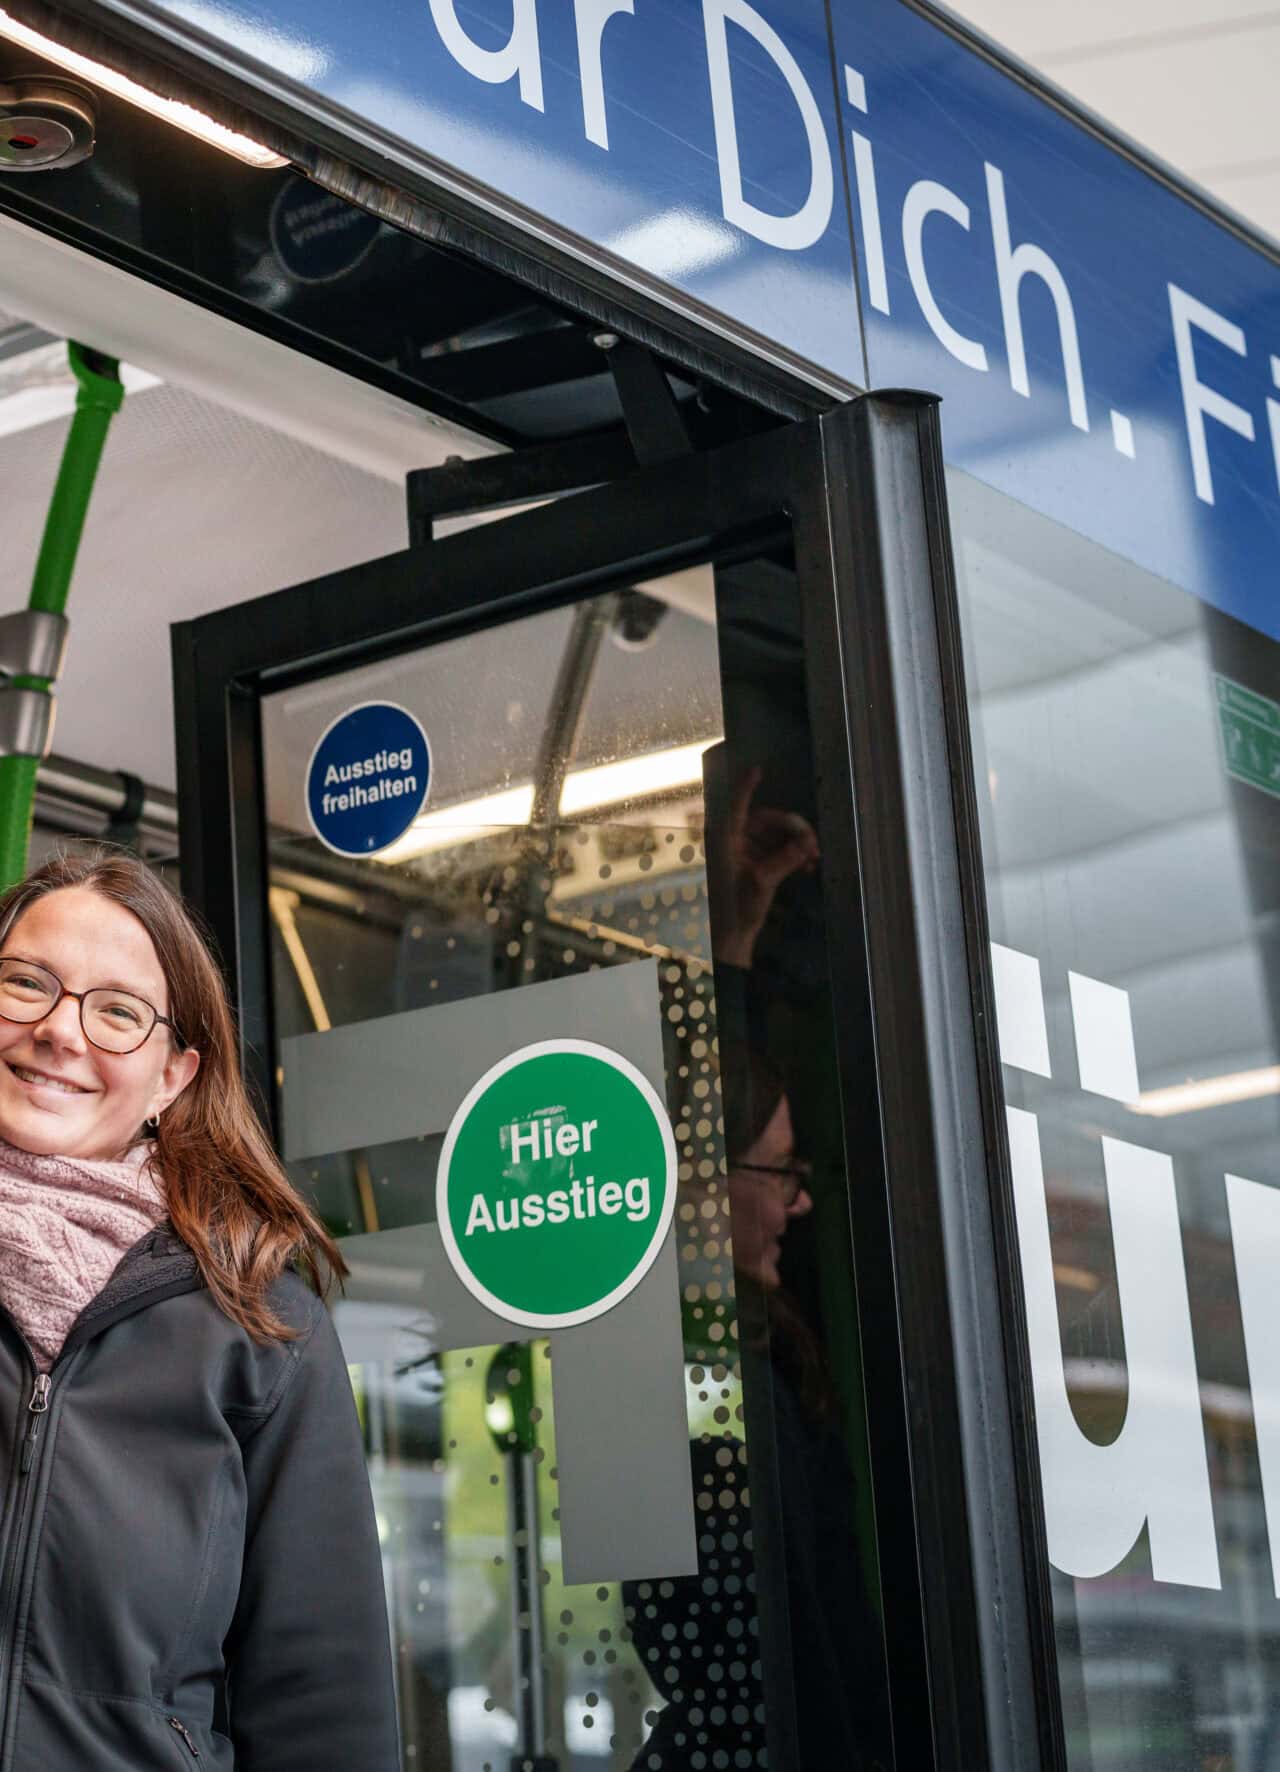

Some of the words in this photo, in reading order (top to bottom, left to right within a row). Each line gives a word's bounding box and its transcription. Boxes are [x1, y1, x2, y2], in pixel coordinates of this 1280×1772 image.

[703, 0, 1136, 460] Dich.
[1167, 281, 1280, 506] F
[323, 747, 413, 788] Ausstieg
[322, 775, 417, 816] freihalten
[509, 1118, 598, 1165] Hier
[464, 1175, 651, 1236] Ausstieg
